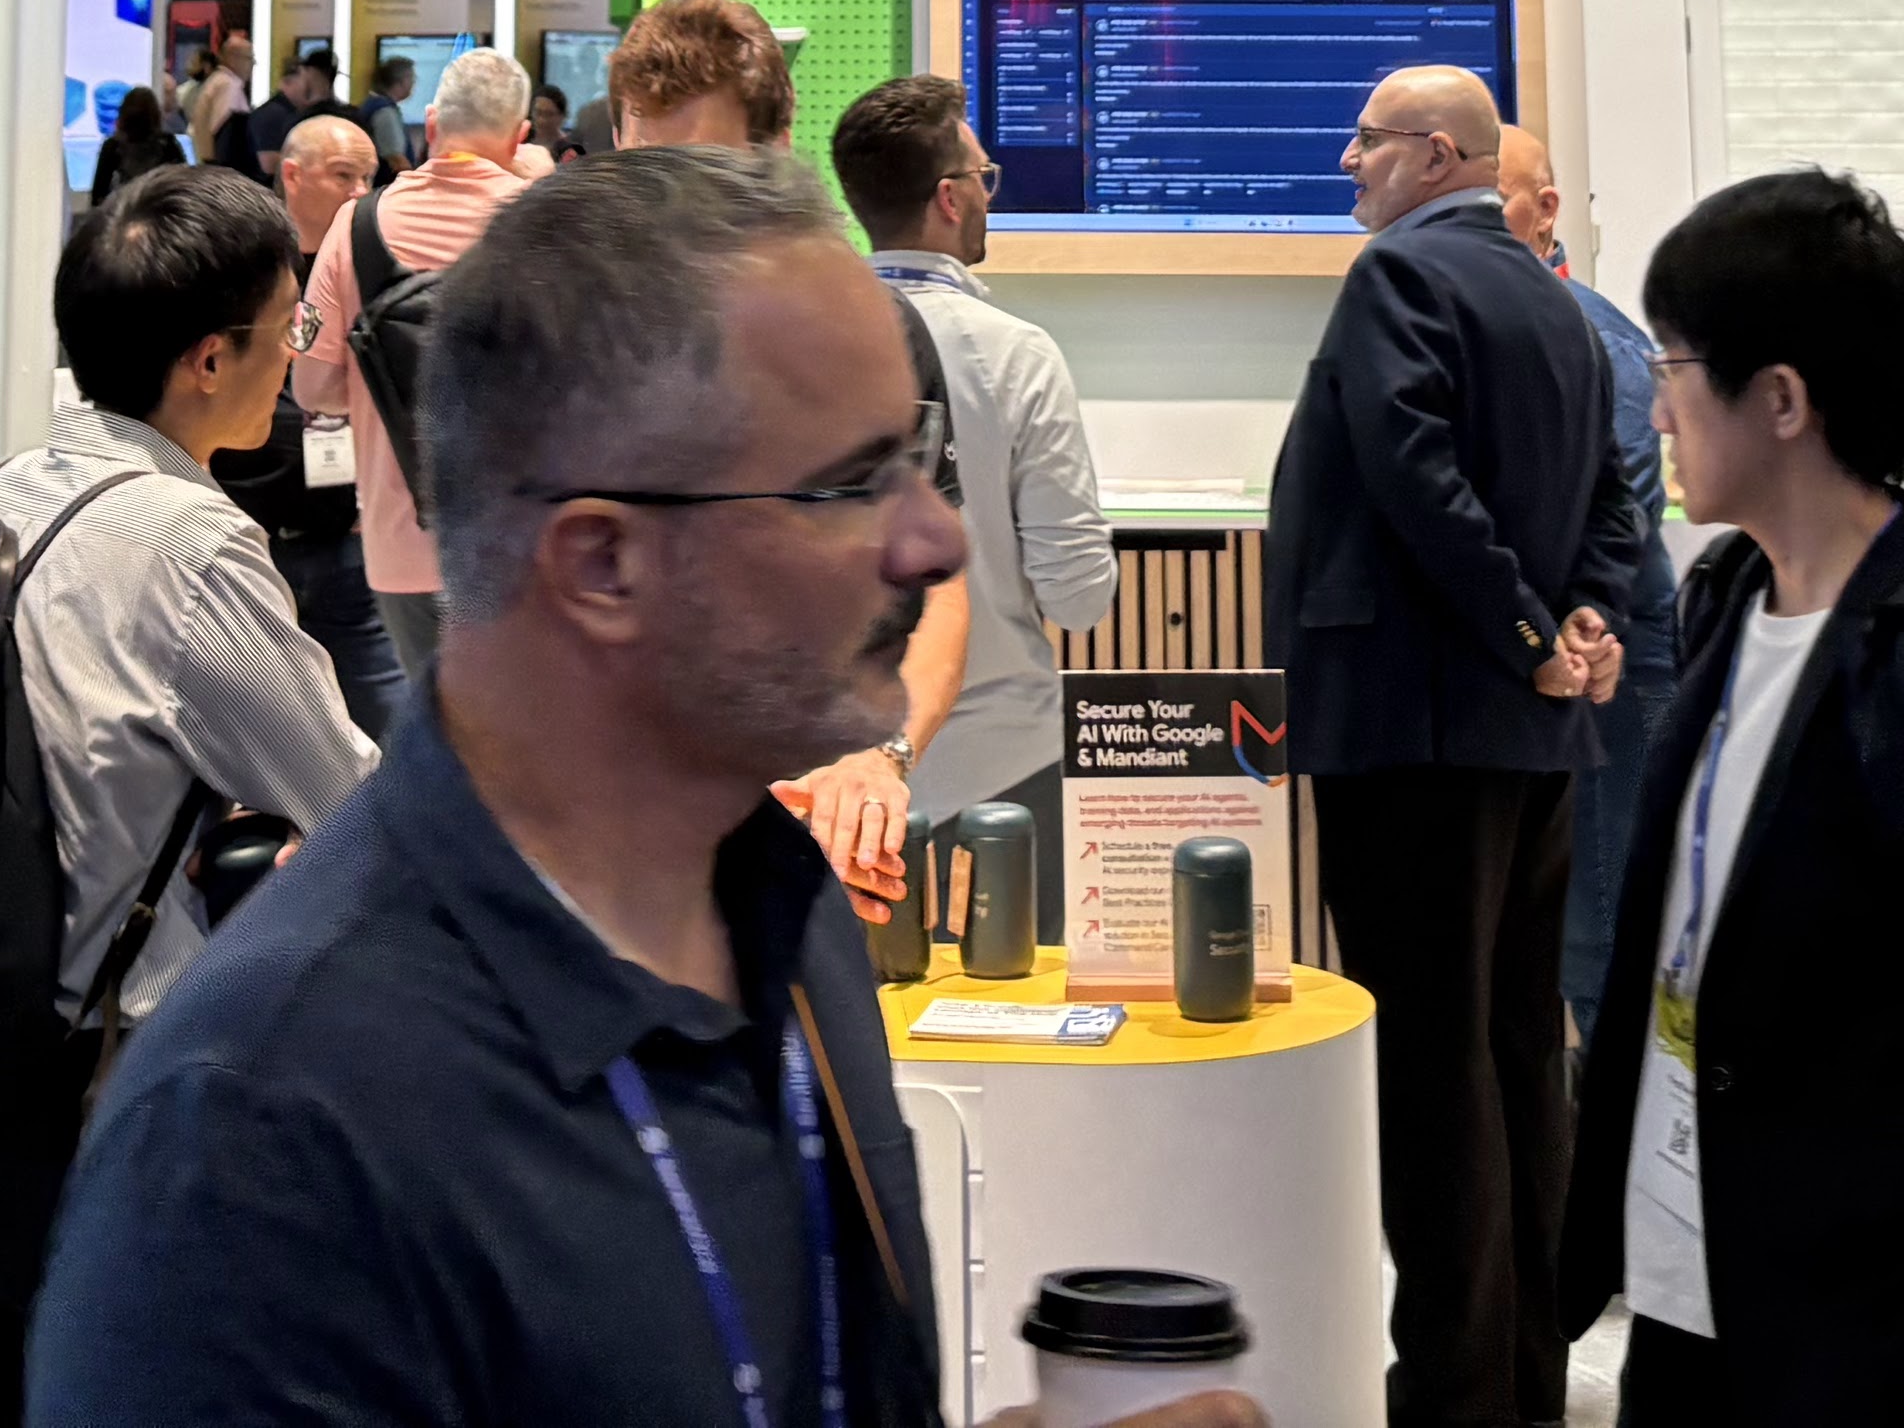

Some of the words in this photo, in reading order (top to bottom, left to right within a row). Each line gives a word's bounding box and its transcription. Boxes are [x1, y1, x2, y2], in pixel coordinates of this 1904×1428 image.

[1076, 700, 1146, 719] Secure
[1148, 700, 1195, 719] Your
[1076, 726, 1098, 743] AI
[1102, 724, 1150, 743] With
[1151, 723, 1225, 747] Google
[1076, 747, 1093, 767] &
[1096, 747, 1190, 767] Mandiant
